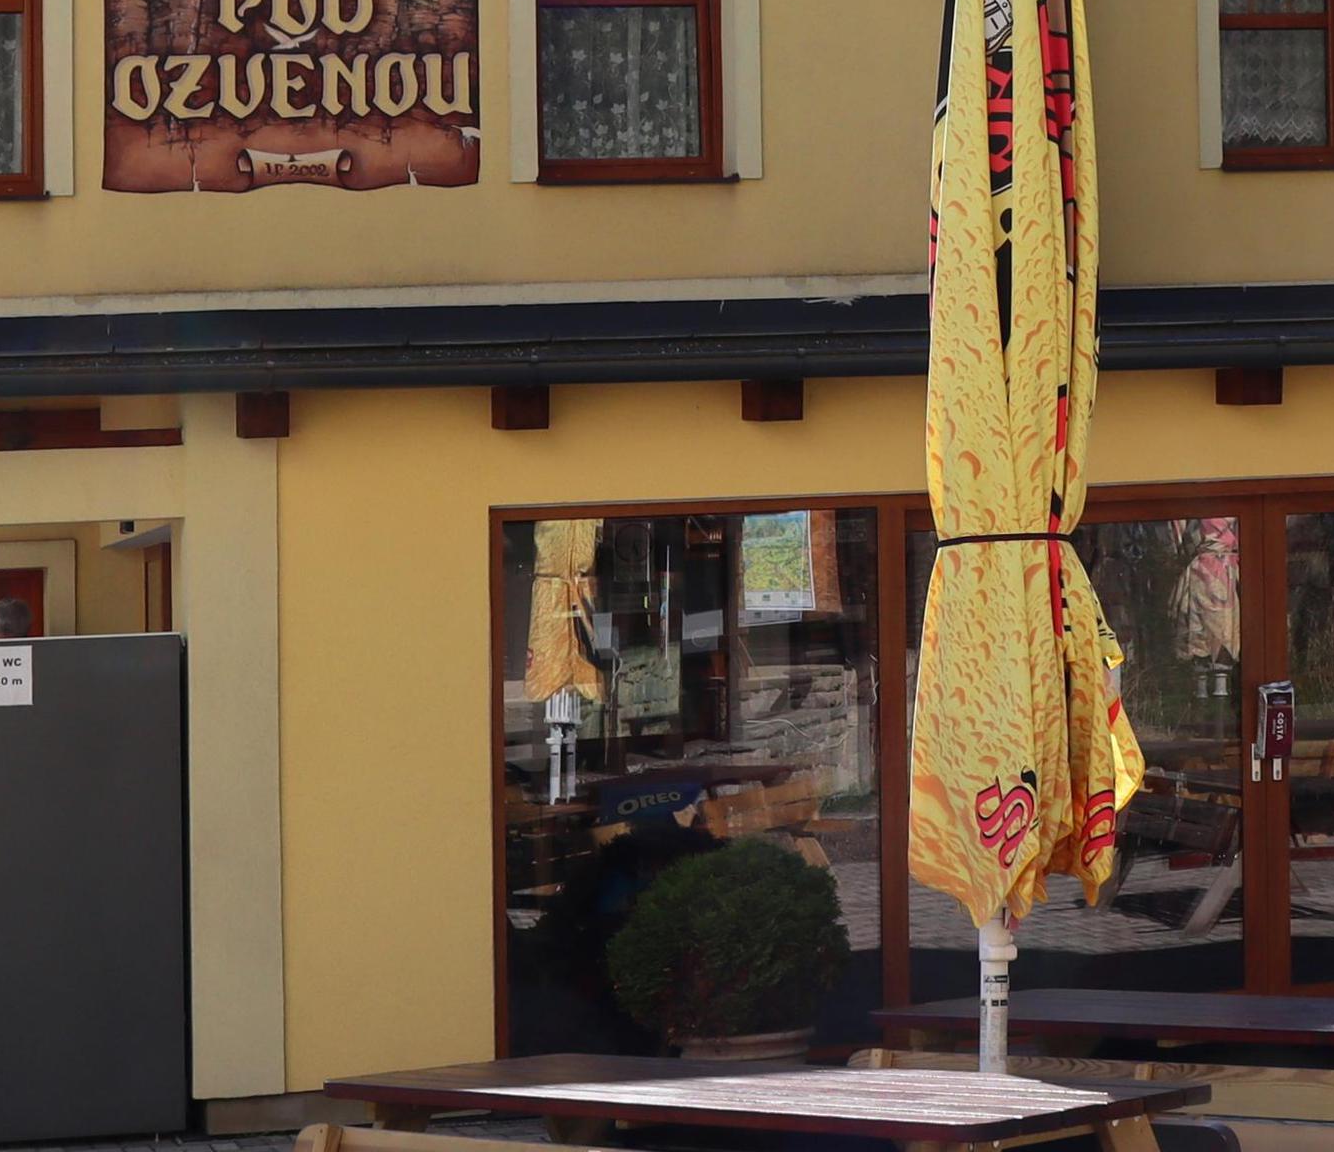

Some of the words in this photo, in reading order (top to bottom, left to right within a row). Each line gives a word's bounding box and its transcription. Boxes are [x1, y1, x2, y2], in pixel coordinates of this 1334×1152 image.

[289, 162, 330, 177] 2002
[2, 657, 22, 667] WC
[11, 677, 23, 686] m
[1276, 712, 1285, 741] COSTA
[617, 791, 681, 815] OREO
